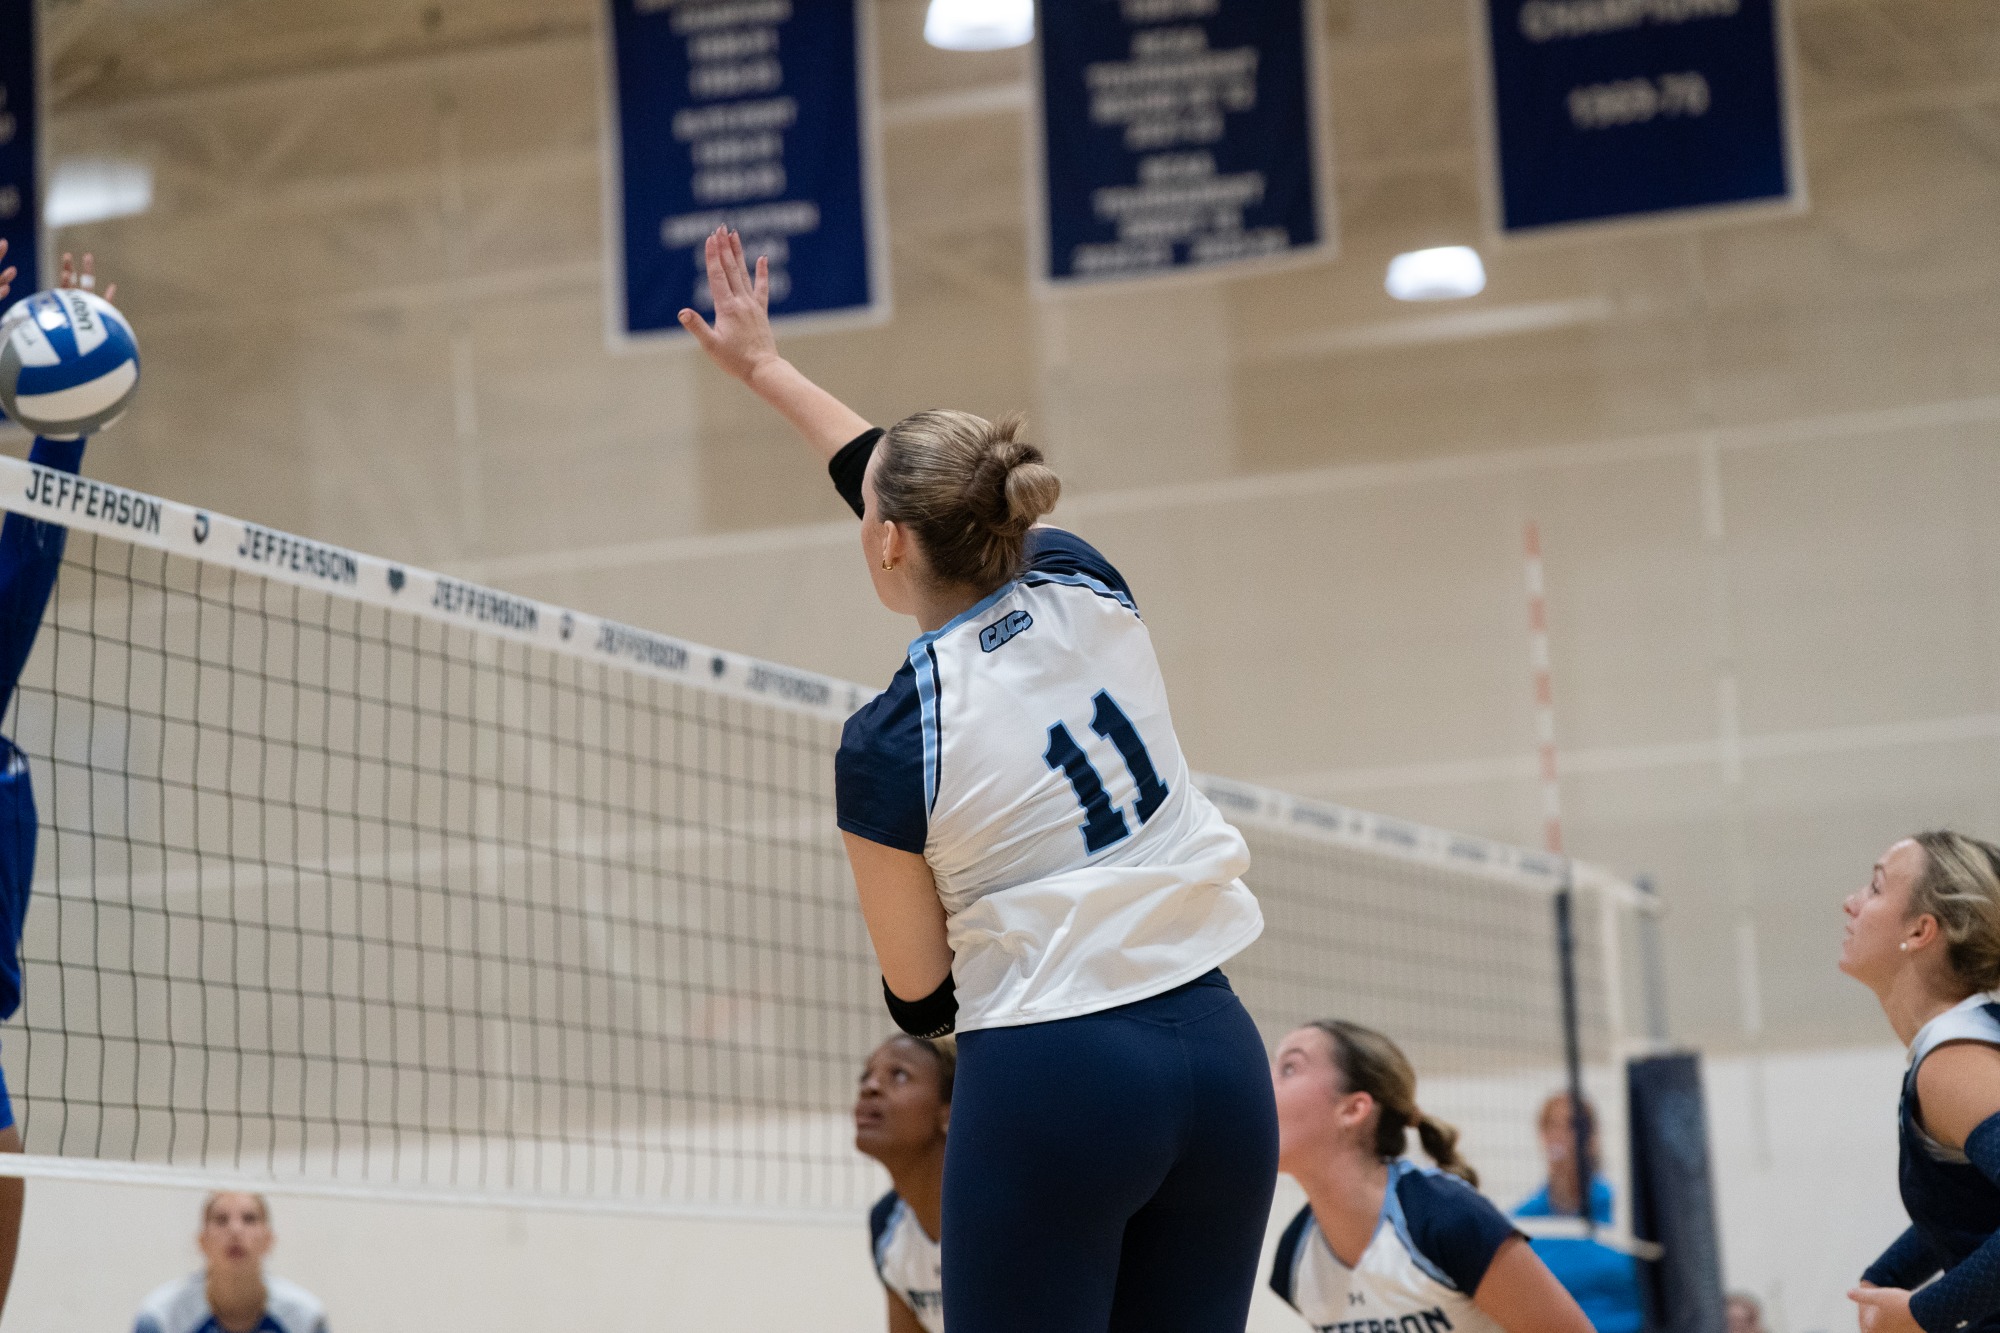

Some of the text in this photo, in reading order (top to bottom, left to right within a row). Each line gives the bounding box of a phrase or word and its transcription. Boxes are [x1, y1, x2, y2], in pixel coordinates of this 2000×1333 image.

[26, 468, 161, 535] JEFFERSON
[238, 527, 357, 584] JEFFERSON
[432, 578, 540, 632] JEFFERSON
[1042, 687, 1170, 857] 11
